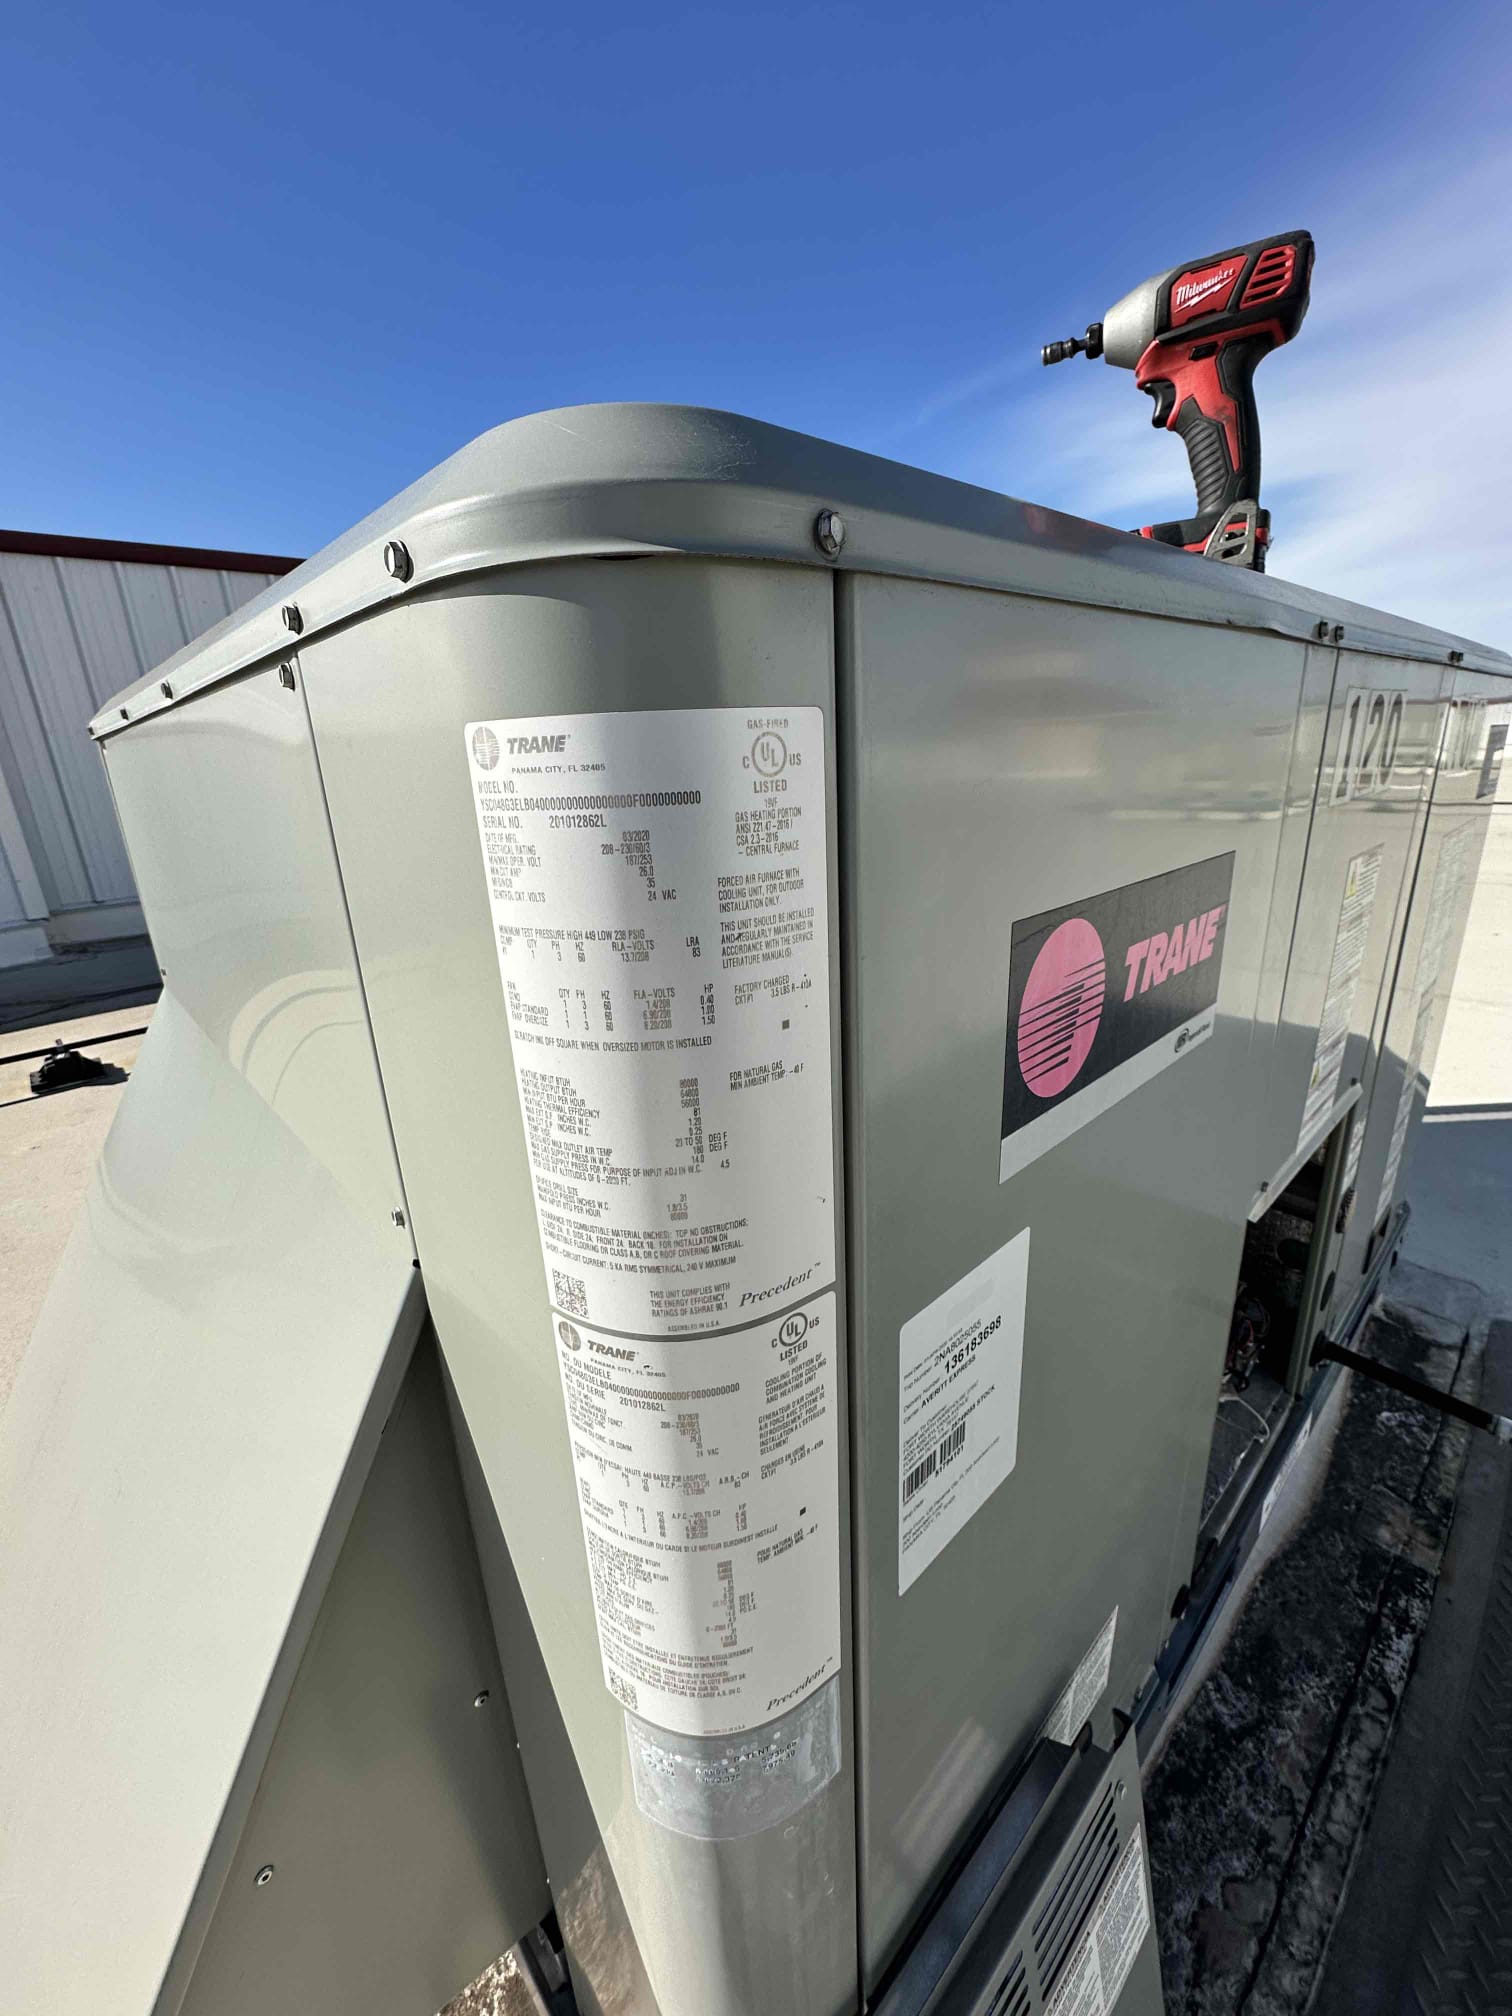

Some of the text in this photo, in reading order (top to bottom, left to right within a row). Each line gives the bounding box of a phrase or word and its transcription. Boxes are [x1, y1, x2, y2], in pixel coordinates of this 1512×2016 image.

[1176, 268, 1235, 305] Milwaukee
[507, 735, 567, 755] TRANE
[760, 741, 779, 768] UL
[789, 753, 801, 766] US
[511, 766, 543, 774] PANAMA
[545, 765, 566, 774] CITY,
[580, 763, 606, 772] 32405
[478, 780, 519, 793] MODEL NO.
[754, 779, 788, 794] LISTED
[483, 814, 607, 829] SERIAL NO. 201012862L
[735, 806, 801, 823] GAS HEATING PORTION
[622, 830, 650, 842] 03/2020
[735, 823, 750, 835] ANSI
[736, 833, 749, 846] CSA
[745, 841, 800, 857] CENTRAL FURNACE
[527, 854, 652, 867] VOLT 187/253
[639, 865, 654, 877] 26.0
[717, 868, 800, 887] FORCED AIR FURNACE WITH
[647, 877, 656, 888] 35
[718, 879, 804, 901] COOLING UNIT, FOR OUTDOOR
[527, 889, 677, 903] VOLTS 24 VAC
[719, 895, 782, 913] INSTALLATION ONLY.
[720, 907, 815, 932] THIS UNIT SHOULD BE INSTALLED
[521, 928, 534, 937] TEST
[535, 928, 565, 940] PRESSURE
[566, 930, 583, 941] HIGH
[597, 930, 613, 941] LOW
[628, 928, 645, 940] PSIG
[721, 933, 735, 945] AND
[773, 921, 806, 936] MAINTAINED
[527, 939, 537, 948] QTY
[552, 941, 560, 950] PH
[575, 941, 584, 951] HZ
[686, 936, 699, 947] LRA
[721, 930, 814, 956] ACCORDANCE WITH THE SERVICE
[692, 947, 701, 957] 83
[1123, 903, 1229, 1003] TRANE
[722, 954, 760, 969] LITERATURE
[558, 988, 570, 998] QTY
[576, 989, 585, 999] PH
[601, 990, 610, 1000] HZ
[704, 983, 714, 993] HP
[734, 975, 790, 995] FACTORY CHARGED
[771, 987, 780, 998] 3.5
[780, 985, 791, 996] LBS
[702, 1015, 716, 1025] 1.50
[514, 1030, 534, 1044] SCRATCH
[545, 1034, 555, 1045] OFF
[556, 1036, 580, 1050] SQUARE
[581, 1039, 600, 1051] WHEN
[602, 1040, 639, 1052] OVERSIZED
[641, 1040, 665, 1051] MOTOR
[667, 1039, 674, 1049] IS
[676, 1036, 712, 1049] INSTALLED
[729, 1060, 783, 1081] FOR NATURAL GAS
[730, 1081, 743, 1092] MIN
[743, 1075, 769, 1089] AMBIENT
[542, 1102, 600, 1119] THERMAL EFFICIENCY
[708, 1133, 722, 1143] DEG
[563, 1141, 613, 1157] OUTLET AIR TEMP
[709, 1143, 722, 1153] DEG
[720, 1159, 730, 1168] 4.5
[674, 1232, 728, 1248] INSTALLATION ON
[678, 1245, 710, 1257] COVERING
[650, 1282, 731, 1299] THIS UNIT COMPLIES WITH
[740, 1268, 813, 1307] Precedent
[650, 1293, 725, 1308] THE ENERGY EFFICIENCY
[651, 1302, 728, 1318] RATINGS OF ASHRAE 90.1
[786, 1321, 802, 1337] UL
[809, 1316, 820, 1330] US
[587, 1340, 636, 1361] TRANE
[771, 1338, 778, 1349] C
[780, 1339, 808, 1362] LISTED
[944, 1315, 1001, 1374] 136183698
[584, 1362, 612, 1380] MODELE
[765, 1369, 790, 1387] COOLING
[791, 1358, 815, 1377] PORTION
[765, 1358, 827, 1396] COMBINATION COOLING
[779, 1372, 816, 1398] HEATING UNIT
[922, 1354, 976, 1408] AVERITT EXPRESS
[619, 1396, 666, 1412] 201012862L
